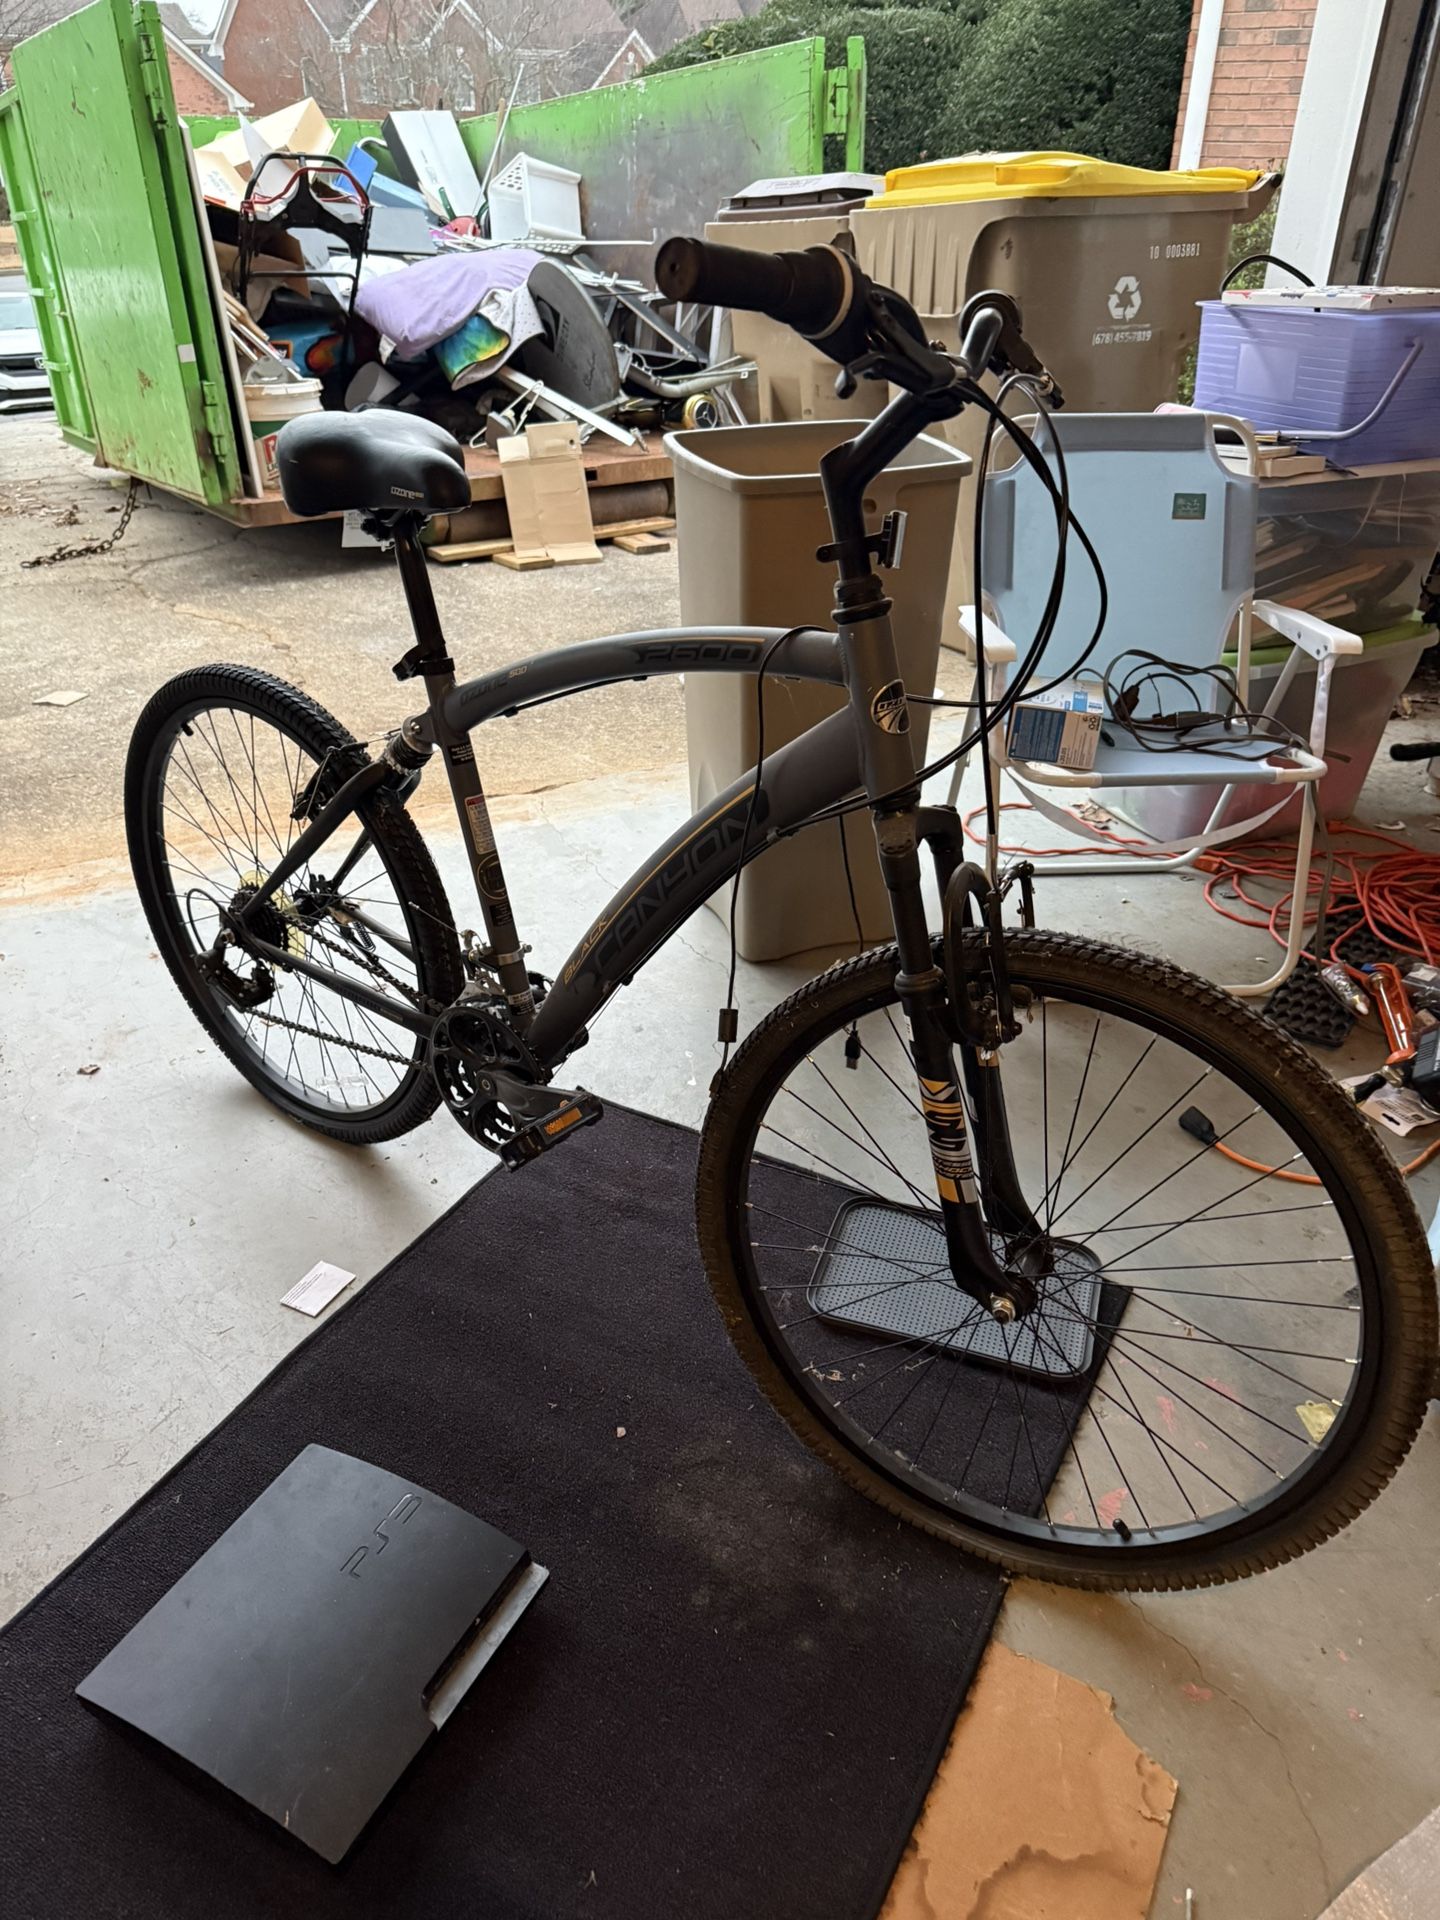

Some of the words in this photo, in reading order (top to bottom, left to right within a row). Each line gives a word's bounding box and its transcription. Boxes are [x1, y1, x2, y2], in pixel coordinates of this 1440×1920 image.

[595, 800, 764, 970] CANYON
[563, 914, 608, 985] BLACK
[339, 1491, 423, 1580] PS3
